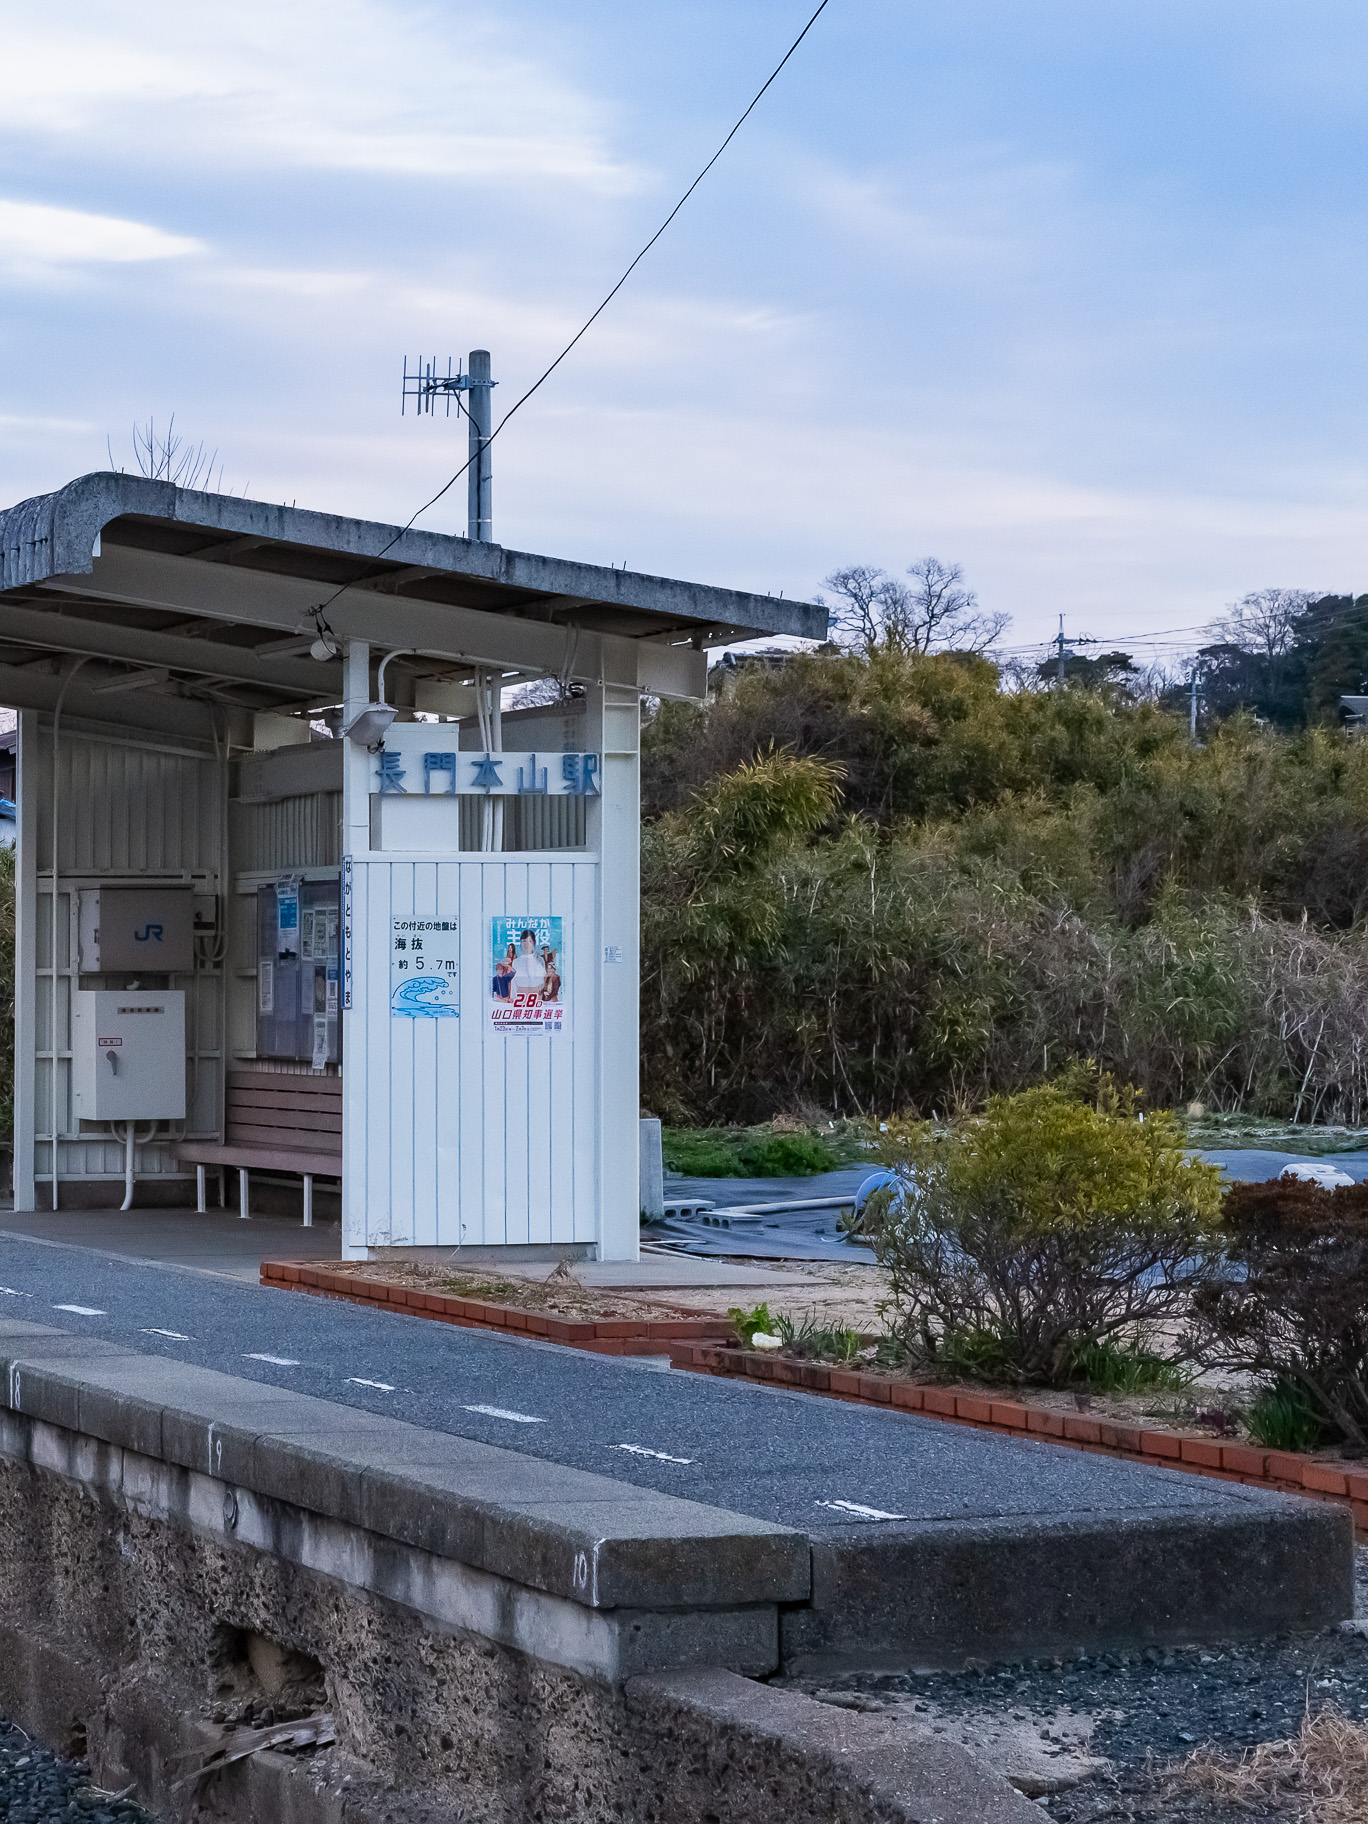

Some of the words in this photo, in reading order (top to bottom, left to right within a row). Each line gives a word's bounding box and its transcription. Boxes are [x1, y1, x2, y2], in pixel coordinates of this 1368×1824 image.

[375, 752, 600, 797] 長門本山駅
[393, 921, 457, 931] この付近の地盤は
[506, 918, 550, 928] みんなが
[134, 924, 163, 941] JR
[394, 938, 423, 950] 海抜
[491, 1009, 563, 1020] 山口県知事選挙
[573, 1550, 587, 1589] 10
